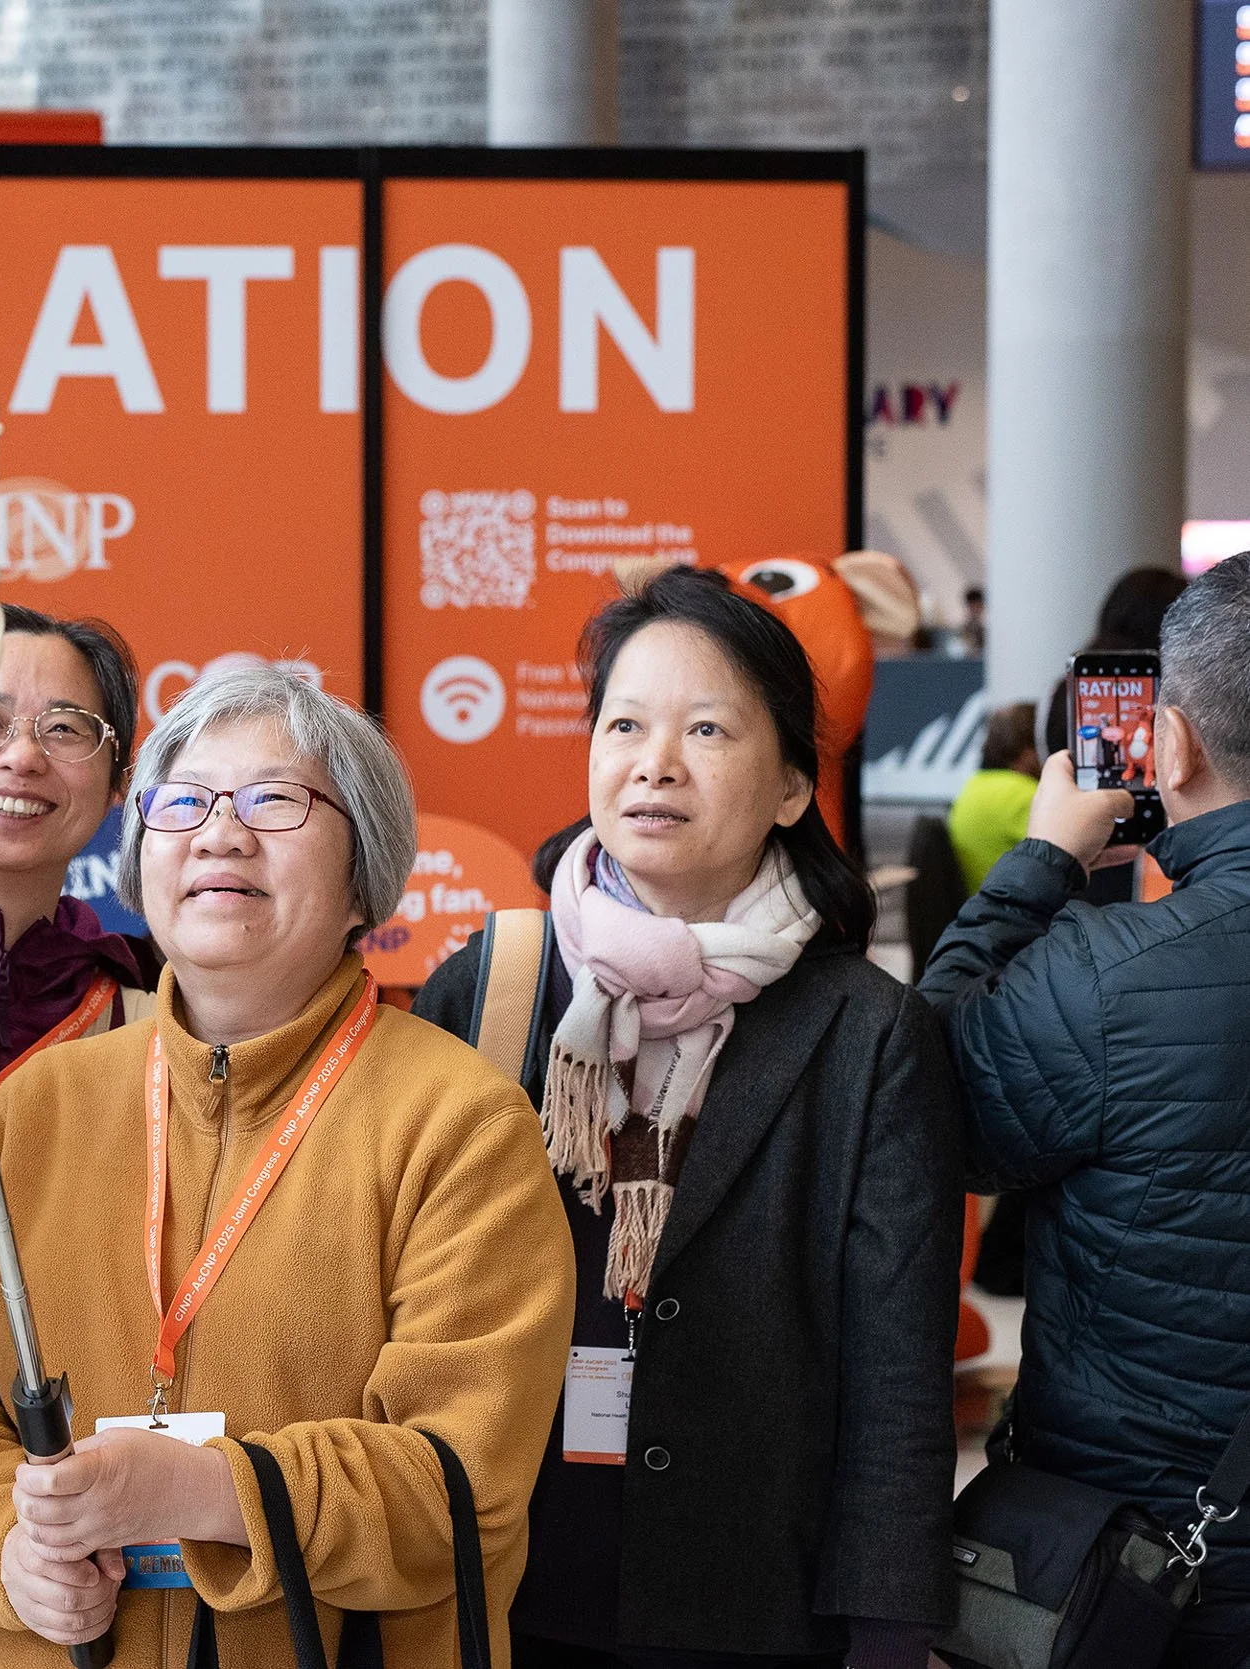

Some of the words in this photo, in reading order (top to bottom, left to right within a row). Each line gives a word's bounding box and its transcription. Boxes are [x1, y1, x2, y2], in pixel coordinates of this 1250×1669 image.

[864, 384, 960, 425] ARY
[1078, 681, 1144, 698] RATION
[431, 884, 494, 914] fan.
[150, 1060, 163, 1122] CINP-AsCNP
[151, 1123, 162, 1147] 2025
[152, 1146, 161, 1173] Joint
[174, 1251, 218, 1323] CINP-AsCNP
[213, 1224, 236, 1254] 2025
[231, 1196, 253, 1226] Joint
[246, 1150, 281, 1198] Congress
[277, 1081, 322, 1147] CINP-AsCNP
[317, 1056, 340, 1083] 2025
[334, 1034, 353, 1059] Joint
[348, 1002, 372, 1037] Congress
[150, 1173, 162, 1221] Congress
[138, 1553, 188, 1574] MEMB
